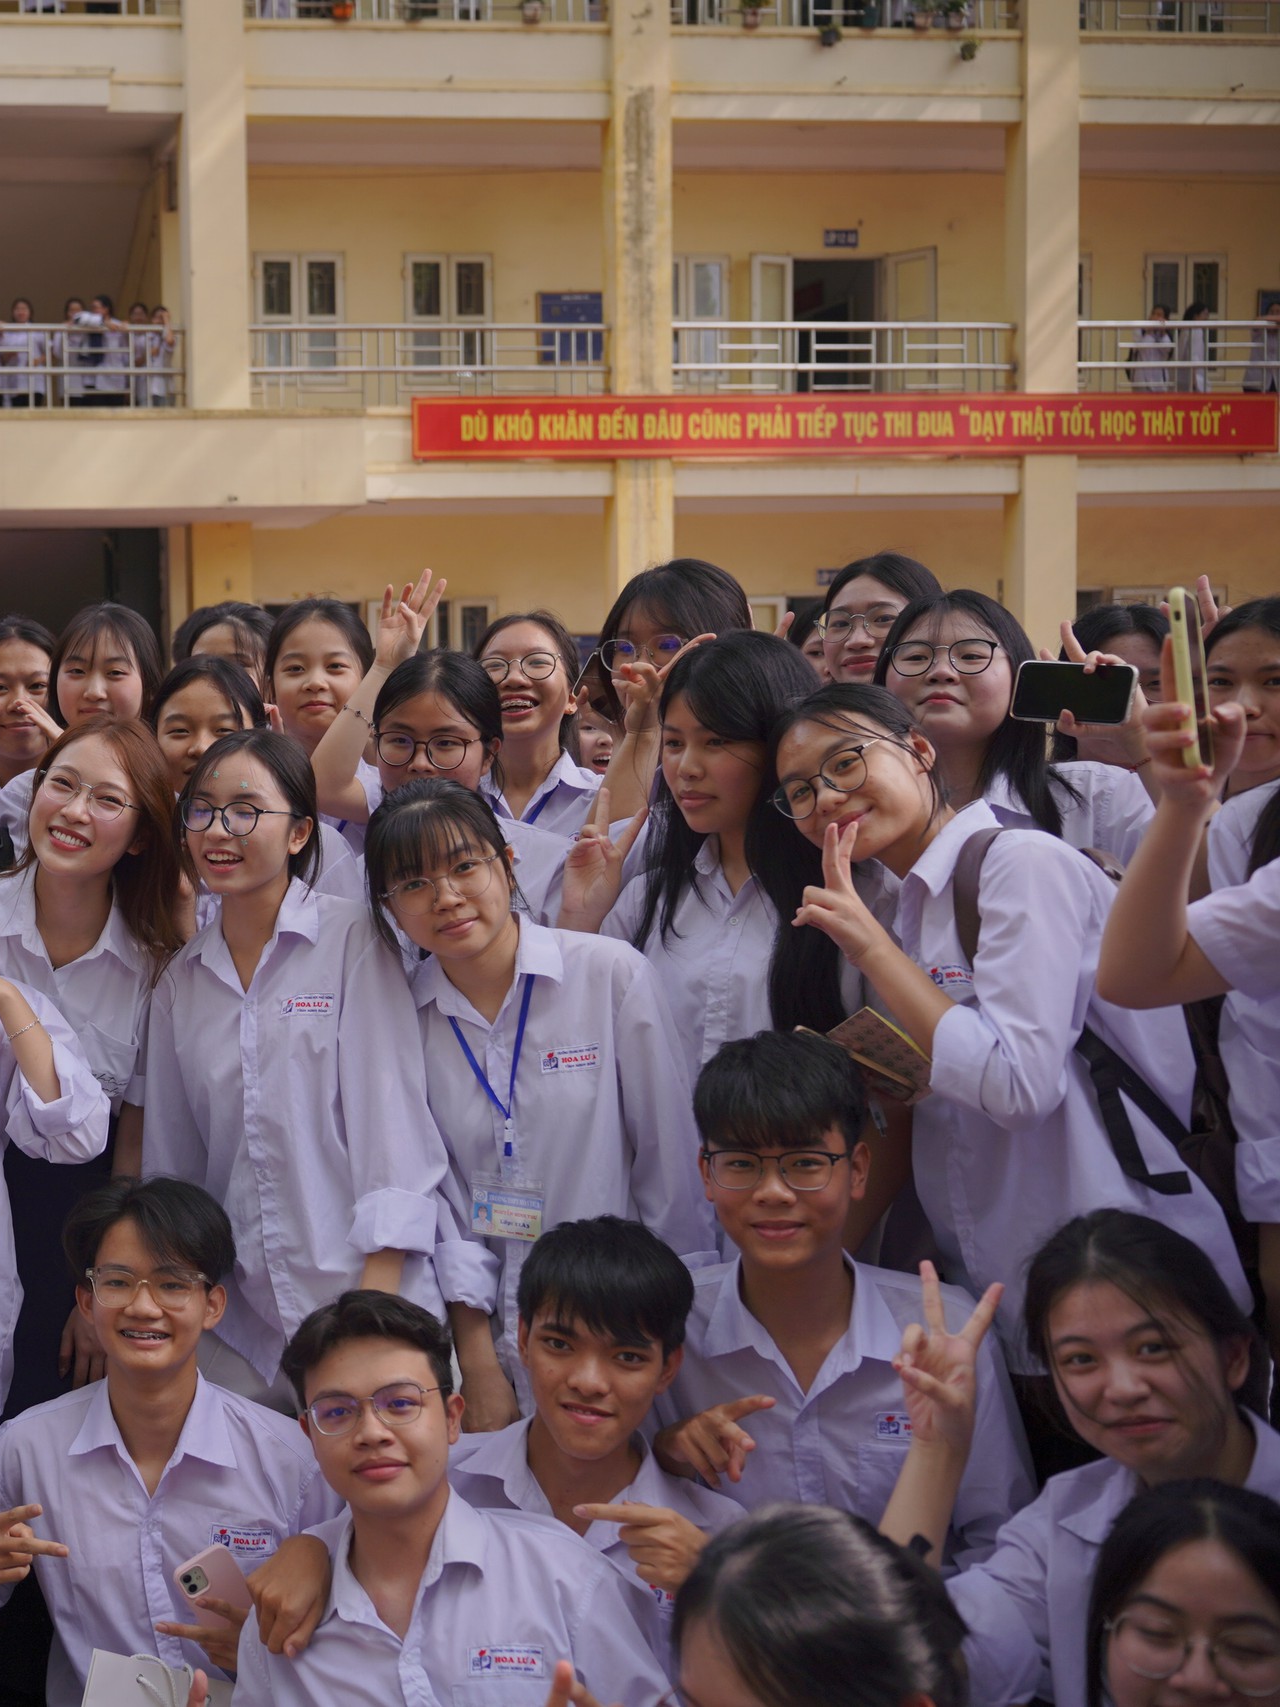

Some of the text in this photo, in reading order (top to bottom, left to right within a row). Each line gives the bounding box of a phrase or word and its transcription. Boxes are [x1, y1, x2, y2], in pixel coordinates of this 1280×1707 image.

[460, 409, 488, 442] DÙ
[493, 409, 535, 441] KHÓ
[539, 408, 594, 442] KHĂN
[598, 406, 639, 440] ĐẾN
[643, 407, 683, 440] ĐÂU
[688, 407, 743, 440] CŨNG
[746, 404, 792, 439] PHẢI
[796, 404, 838, 439] TIẾP
[842, 411, 880, 444] TỤC
[883, 411, 914, 438] THI
[917, 410, 955, 437] ĐUA
[1010, 405, 1057, 443] THẬT
[1060, 402, 1095, 439] TỐT,
[1100, 410, 1137, 443] HỌC
[1142, 405, 1187, 443] THẬT
[233, 1537, 250, 1545] HOA
[494, 1656, 514, 1664] HOA
